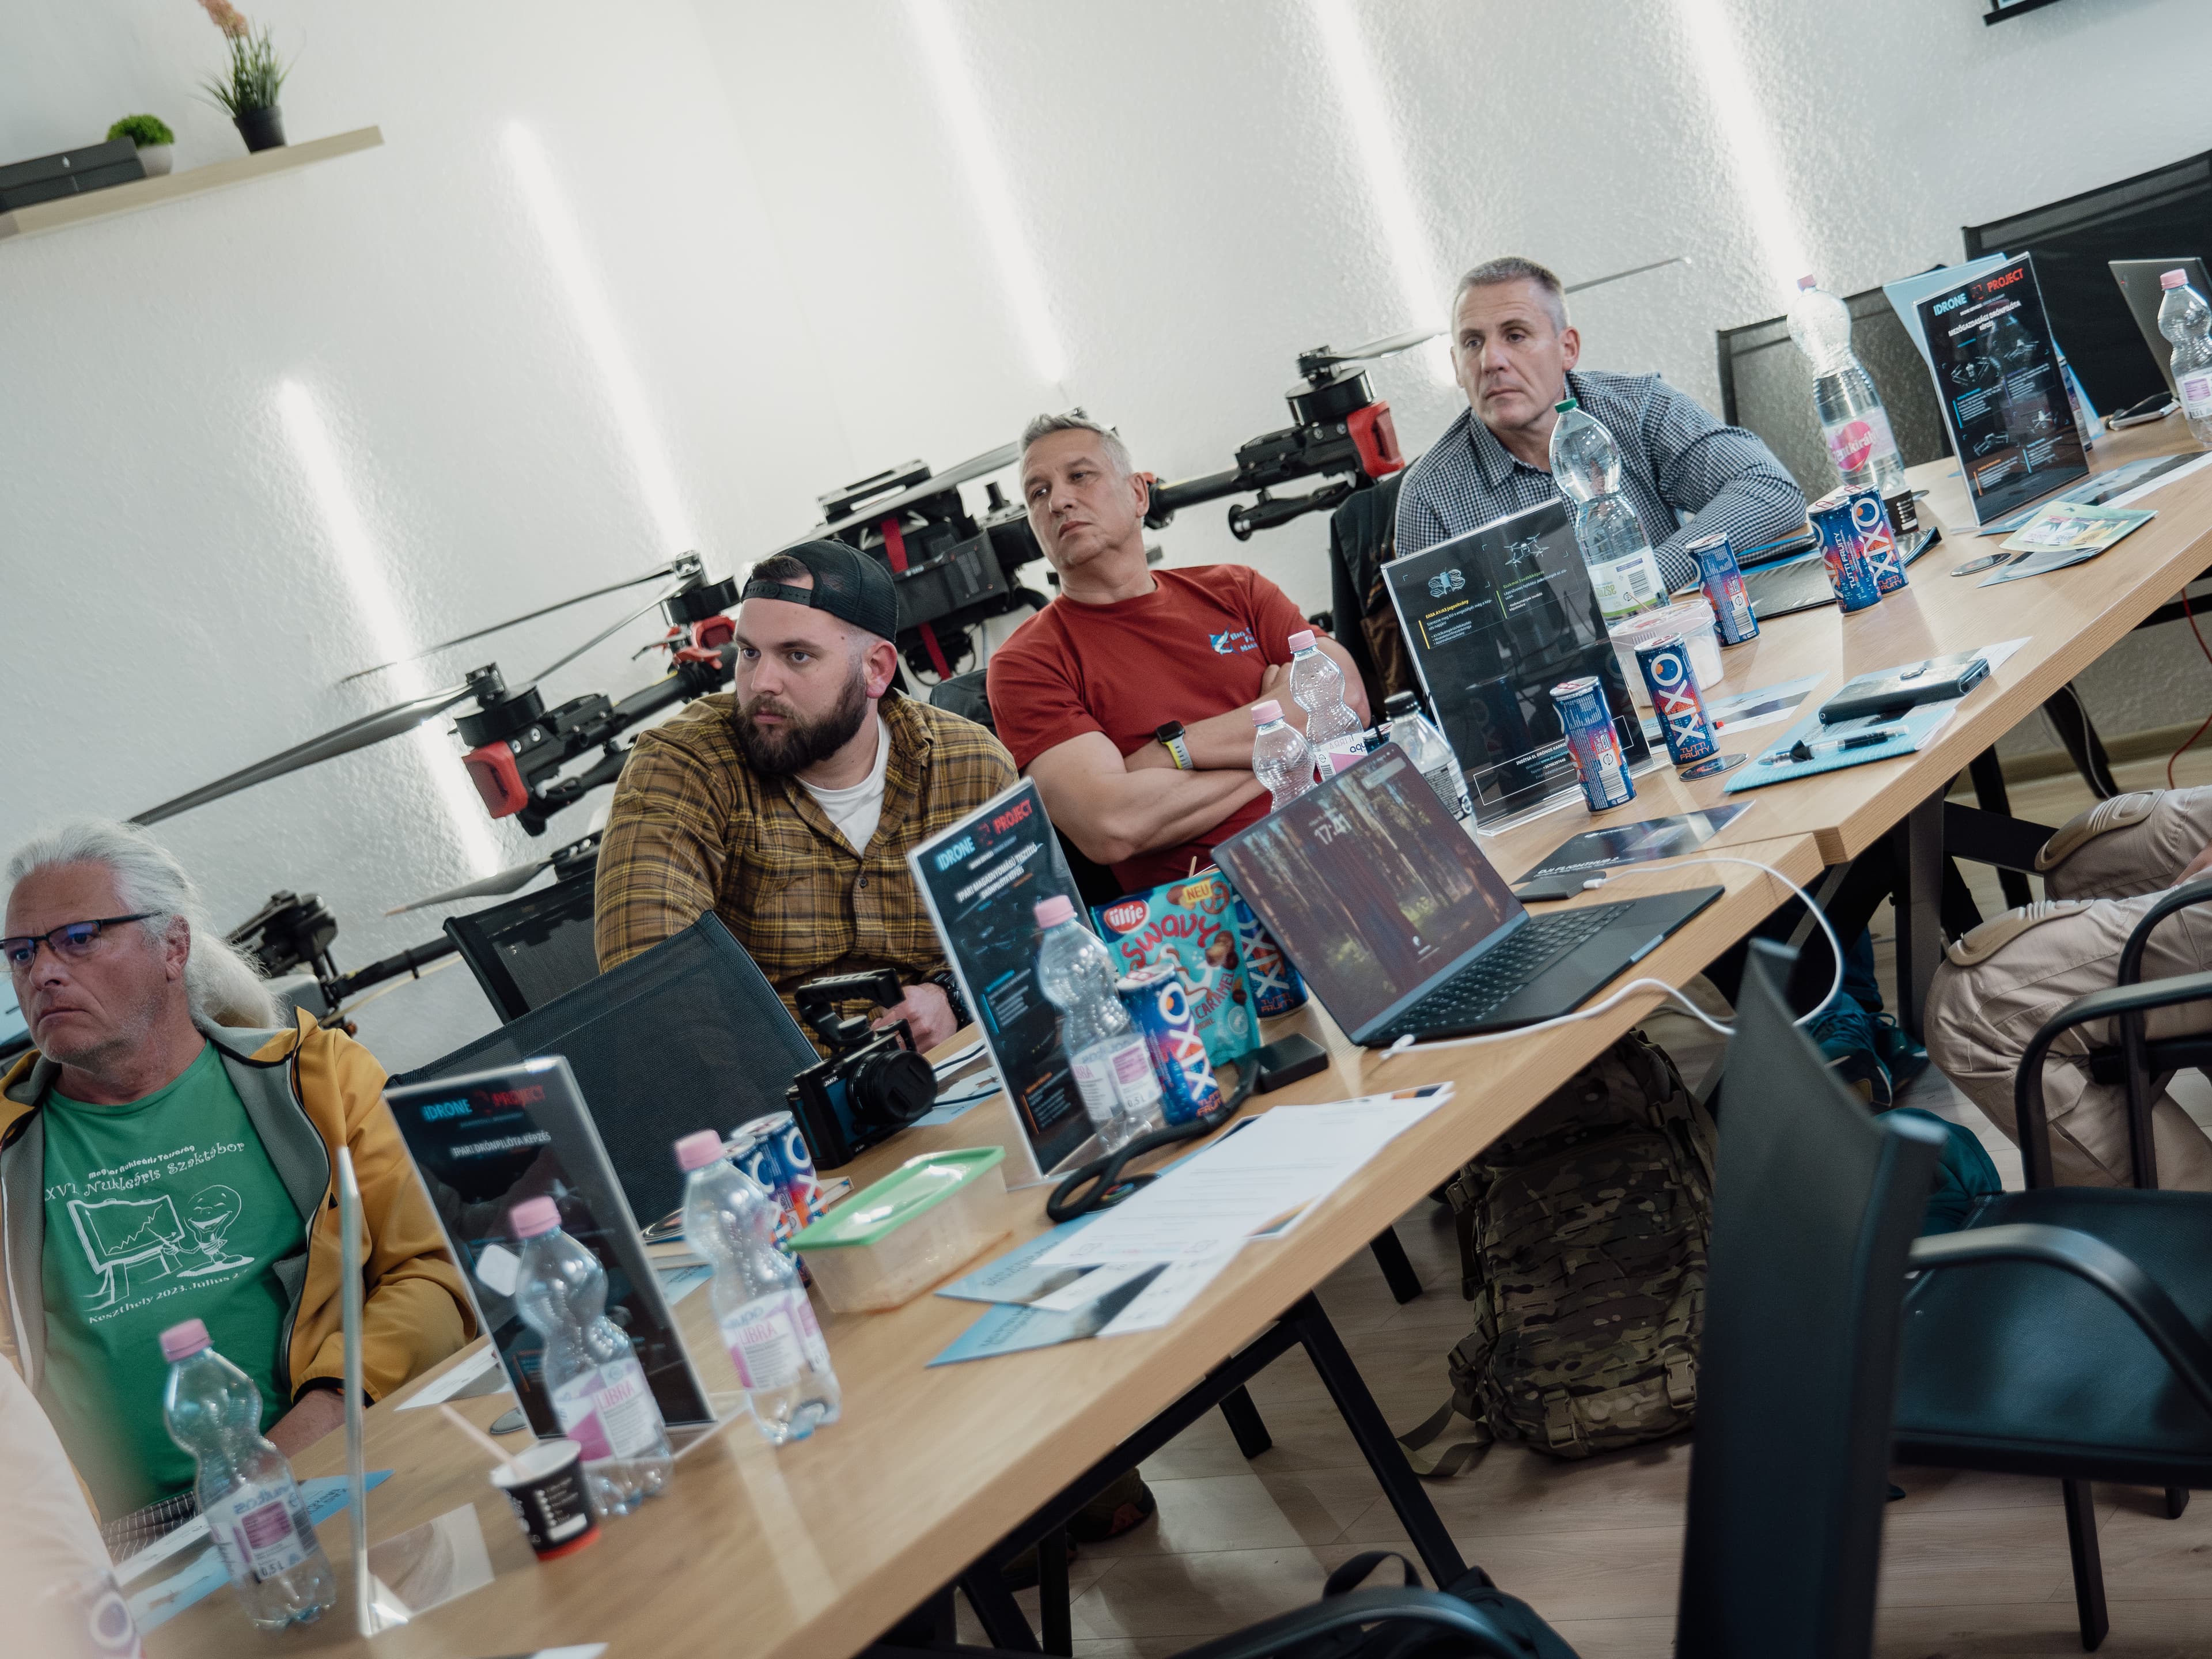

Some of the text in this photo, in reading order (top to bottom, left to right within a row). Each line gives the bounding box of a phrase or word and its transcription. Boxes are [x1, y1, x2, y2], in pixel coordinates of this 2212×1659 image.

[1933, 293, 1968, 316] IDRONE
[1986, 268, 2024, 292] PROJECT
[1834, 532, 1848, 564] FRUITY
[1851, 498, 1899, 579] XIXO
[1844, 565, 1857, 589] TUTTI
[1435, 607, 1447, 617] A1/A3
[1651, 653, 1706, 747] XIXO
[1536, 748, 1553, 757] DRÓNOS
[1680, 741, 1706, 753] TUTTI
[1680, 745, 1710, 761] FRUITY
[936, 836, 975, 872] IDRONE
[993, 799, 1032, 835] PROJECT
[957, 886, 974, 903] IPARI
[1186, 882, 1210, 901] NEU
[1109, 904, 1144, 927] ültje
[1195, 972, 1235, 1019] CARAMEL
[1158, 982, 1218, 1101] XIXO
[419, 1098, 474, 1123] IDRONE
[84, 1169, 161, 1196] Nukleáris
[166, 1142, 245, 1175] Szaktábor
[89, 1296, 153, 1324] Keszthely
[156, 1285, 188, 1300] 2023.
[596, 1378, 634, 1410] LIBRA
